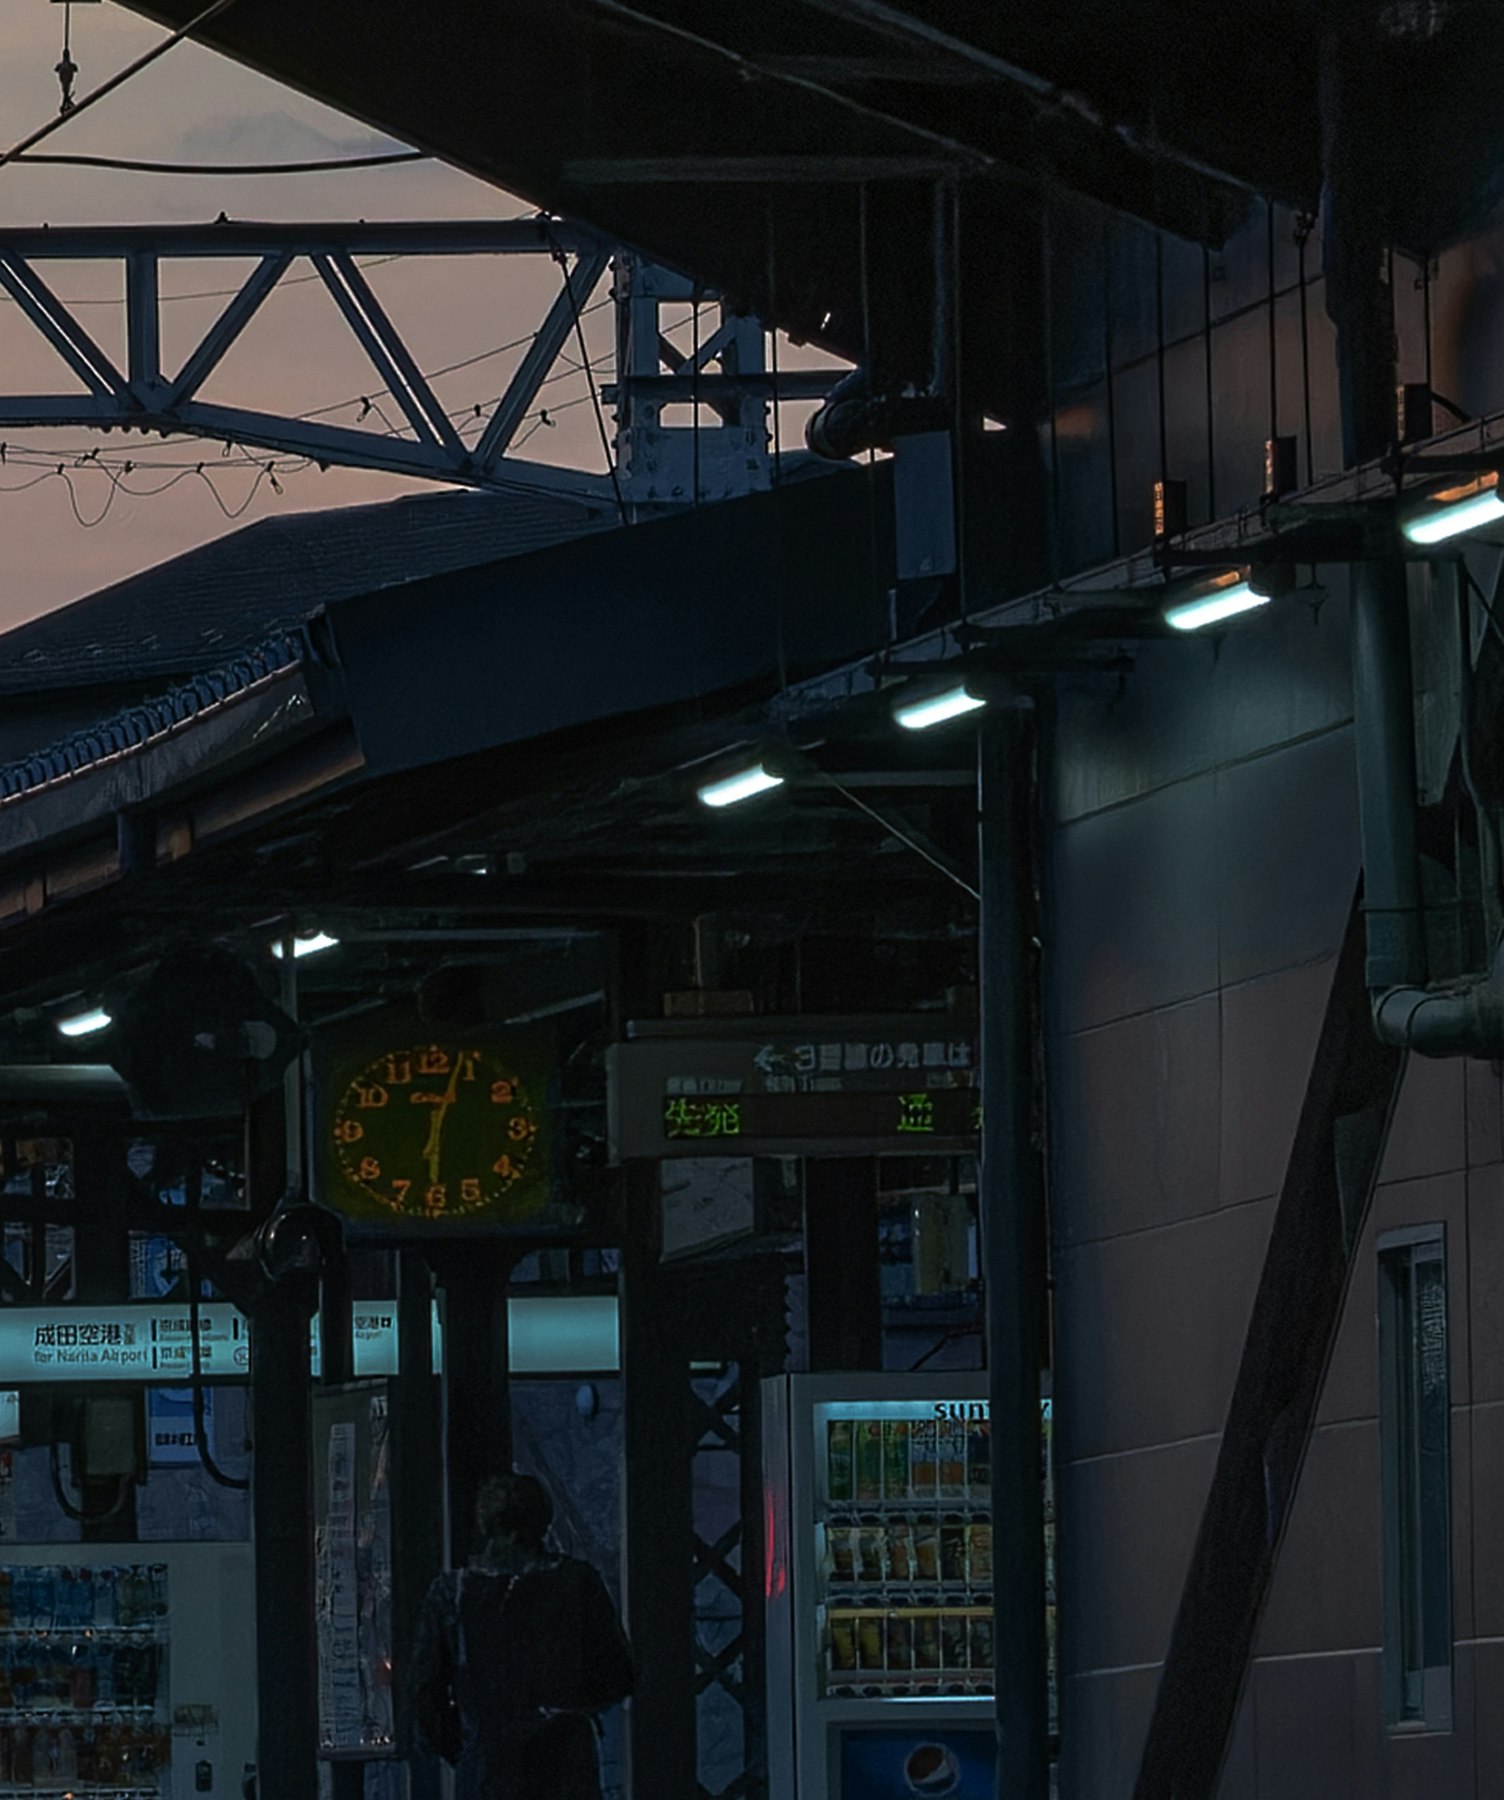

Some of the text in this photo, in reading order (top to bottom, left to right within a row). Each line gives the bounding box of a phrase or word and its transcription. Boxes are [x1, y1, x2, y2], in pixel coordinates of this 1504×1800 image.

[417, 1049, 450, 1075] 12
[357, 1083, 389, 1109] 10
[34, 1323, 122, 1346] 成田空港
[34, 1349, 53, 1363] for
[57, 1349, 98, 1362] Narita
[100, 1348, 148, 1366] Airport
